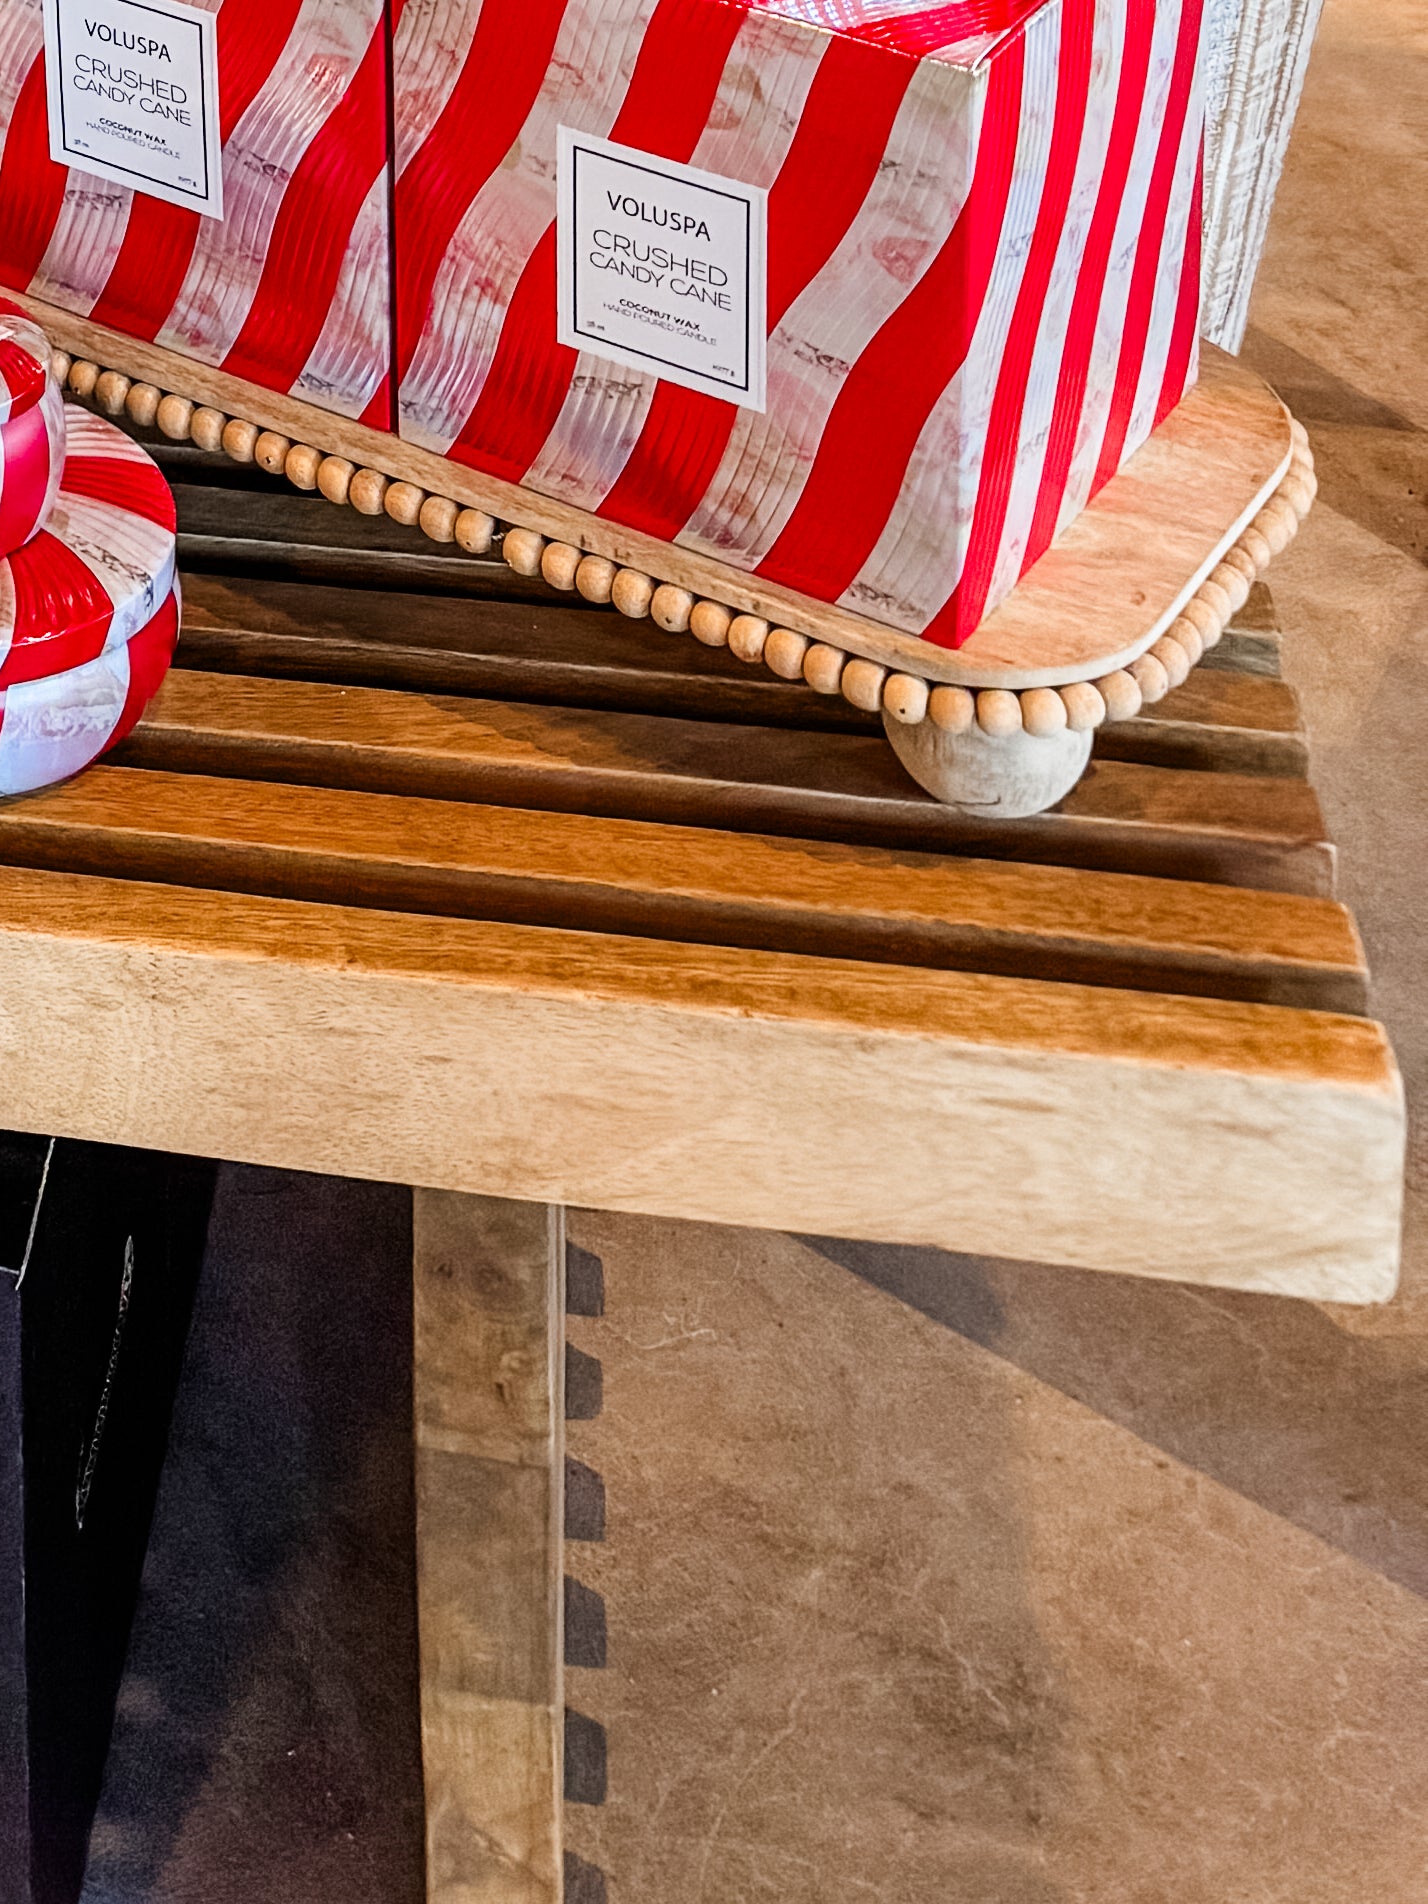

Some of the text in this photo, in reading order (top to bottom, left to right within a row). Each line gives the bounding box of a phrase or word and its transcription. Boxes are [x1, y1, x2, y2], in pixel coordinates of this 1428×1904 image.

[85, 19, 171, 62] VOLUSPA
[73, 75, 192, 126] CANDY CANE
[75, 54, 186, 103] CRUSHED
[607, 190, 710, 241] VOLUSPA
[590, 252, 732, 311] CANDY CANE
[593, 230, 728, 286] CRUSHED
[619, 299, 700, 331] COCONUT WAX
